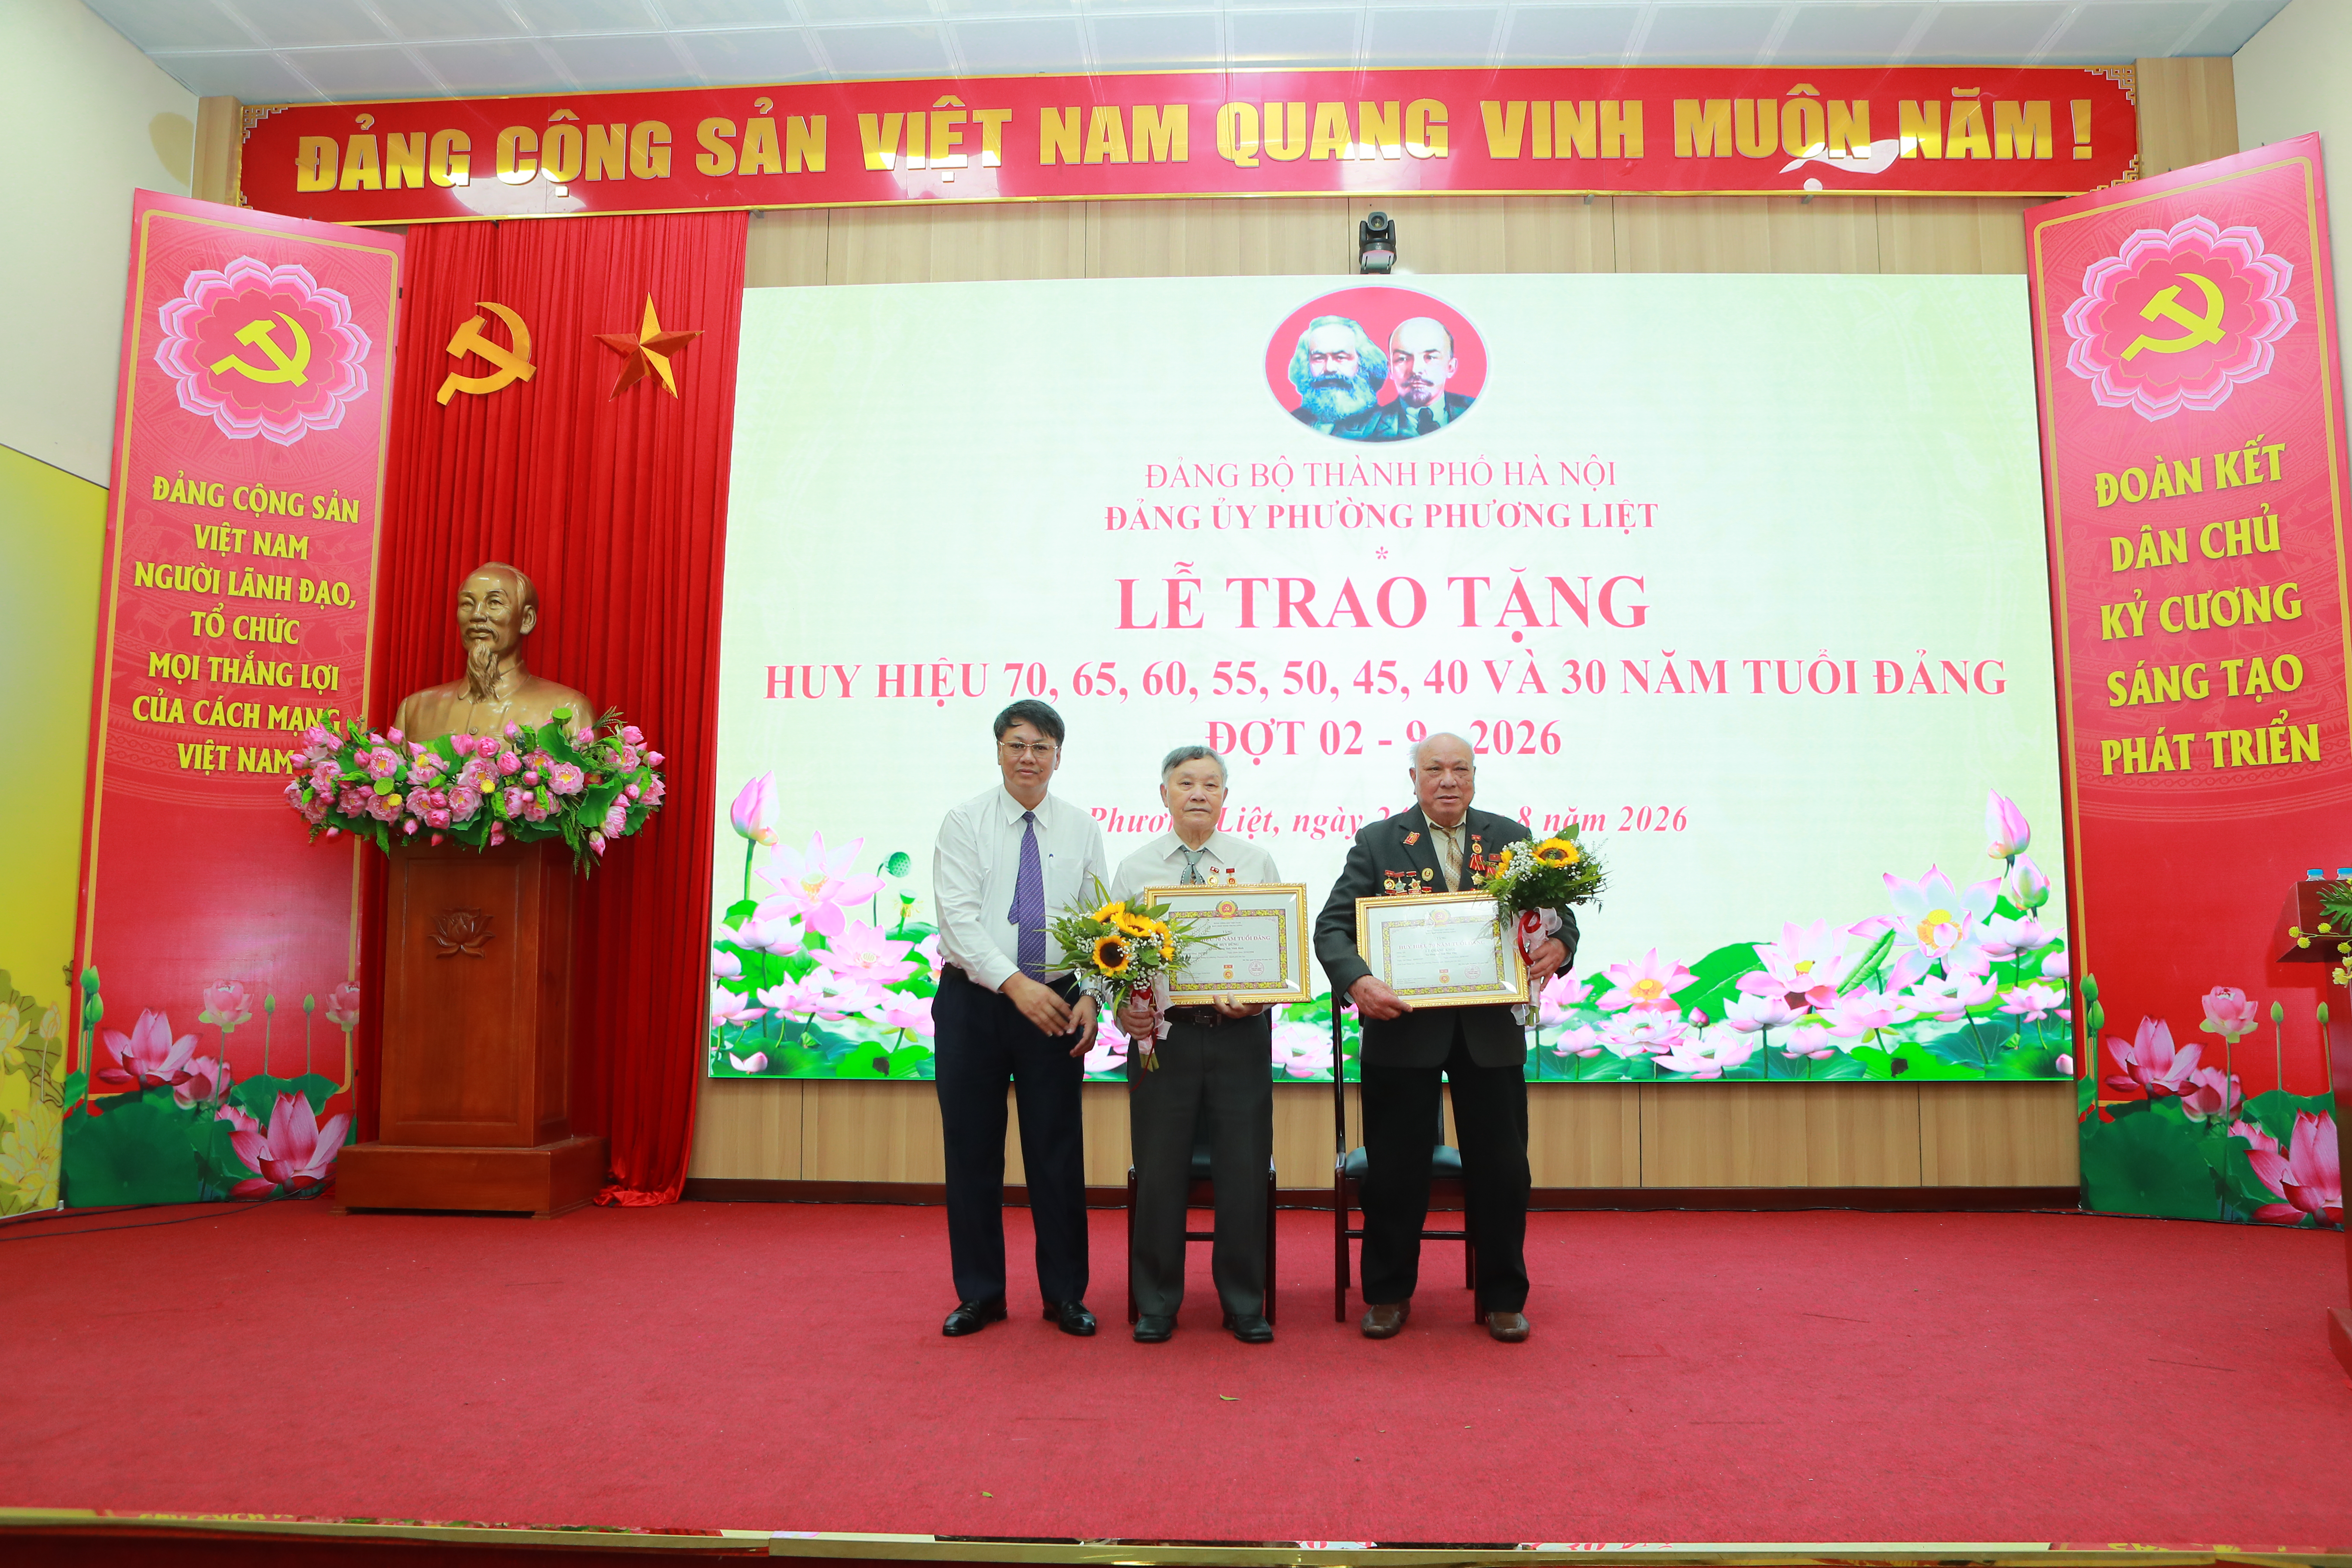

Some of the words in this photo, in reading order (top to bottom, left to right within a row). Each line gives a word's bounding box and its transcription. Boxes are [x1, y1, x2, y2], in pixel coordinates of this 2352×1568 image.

[295, 113, 471, 192] ĐẢNG
[495, 110, 671, 198] CỘNG
[697, 98, 825, 175] SẢN
[858, 95, 1012, 183] VIỆT
[1041, 104, 1188, 163] NAM
[1218, 99, 1449, 165] QUANG
[1481, 101, 1643, 158] VINH
[1900, 88, 2052, 159] NĂM
[1146, 456, 1239, 488] ĐẢNG
[1251, 455, 1293, 492] BỘ
[1304, 455, 1417, 486] THÀNH
[1430, 455, 1492, 486] PHỐ
[1504, 454, 1549, 485] HÀ
[1559, 454, 1615, 491] NỘI
[2095, 456, 2202, 507] ĐOÀN
[2215, 435, 2285, 488] KẾT
[153, 471, 224, 507] ĐẢNG
[233, 484, 304, 517] CỘNG
[313, 490, 359, 523] SẢN
[1105, 498, 1200, 530] ĐẢNG
[1212, 497, 1257, 529] ỦY
[1268, 497, 1413, 528] PHƯỜNG
[1425, 499, 1571, 528] PHƯƠNG
[1582, 499, 1658, 534] LIỆT
[195, 522, 246, 556] VIỆT
[253, 531, 308, 560] NAM
[2111, 525, 2188, 571] DÂN
[2200, 503, 2281, 559] CHỦ
[135, 562, 220, 594] NGƯỜI
[228, 567, 292, 600] LÃNH
[299, 579, 355, 609] ĐẠO,
[1115, 561, 1204, 629] LỄ
[1226, 576, 1427, 628] TRAO
[1448, 567, 1650, 643] TẶNG
[191, 603, 224, 637] TỔ
[233, 613, 299, 644] CHỨC
[2101, 589, 2148, 640] KỶ
[2160, 583, 2302, 632] CƯƠNG
[149, 652, 199, 684] MỌI
[208, 651, 293, 686] THẮNG
[301, 665, 339, 694] LỢI
[765, 665, 862, 698] HUY
[876, 657, 989, 707] HIỆU
[1004, 662, 1058, 704] 70,
[1073, 662, 1128, 703] 65,
[1142, 661, 1198, 703] 60,
[1213, 661, 1268, 702] 55,
[1283, 660, 1339, 702] 50,
[1353, 660, 1409, 702] 45,
[1424, 659, 1468, 694] 40
[1482, 649, 1549, 693] VÀ
[1562, 659, 1606, 694] 30
[1620, 649, 1729, 693] NĂM
[1743, 649, 1859, 694] TUỔI
[1873, 649, 2007, 695] ĐẢNG
[2108, 661, 2209, 707] SÁNG
[2220, 655, 2303, 702] TẠO
[133, 689, 184, 723] CỦA
[193, 696, 260, 728] CÁCH
[267, 704, 340, 737] MẠNG
[178, 740, 231, 775] VIỆT
[236, 745, 295, 774] NAM
[1205, 718, 1305, 766] ĐỢT
[1320, 720, 1363, 755] 02
[1406, 720, 1427, 742] 9
[1470, 720, 1561, 755] 2026
[2101, 727, 2195, 775] PHÁT
[2206, 710, 2321, 767] TRIỂN
[1090, 807, 1174, 833] Phươ
[1217, 807, 1279, 839] Liệt,
[1292, 806, 1363, 840] ngày
[1517, 806, 1532, 828] 8
[1543, 806, 1606, 832] năm
[1617, 805, 1688, 831] 2026
